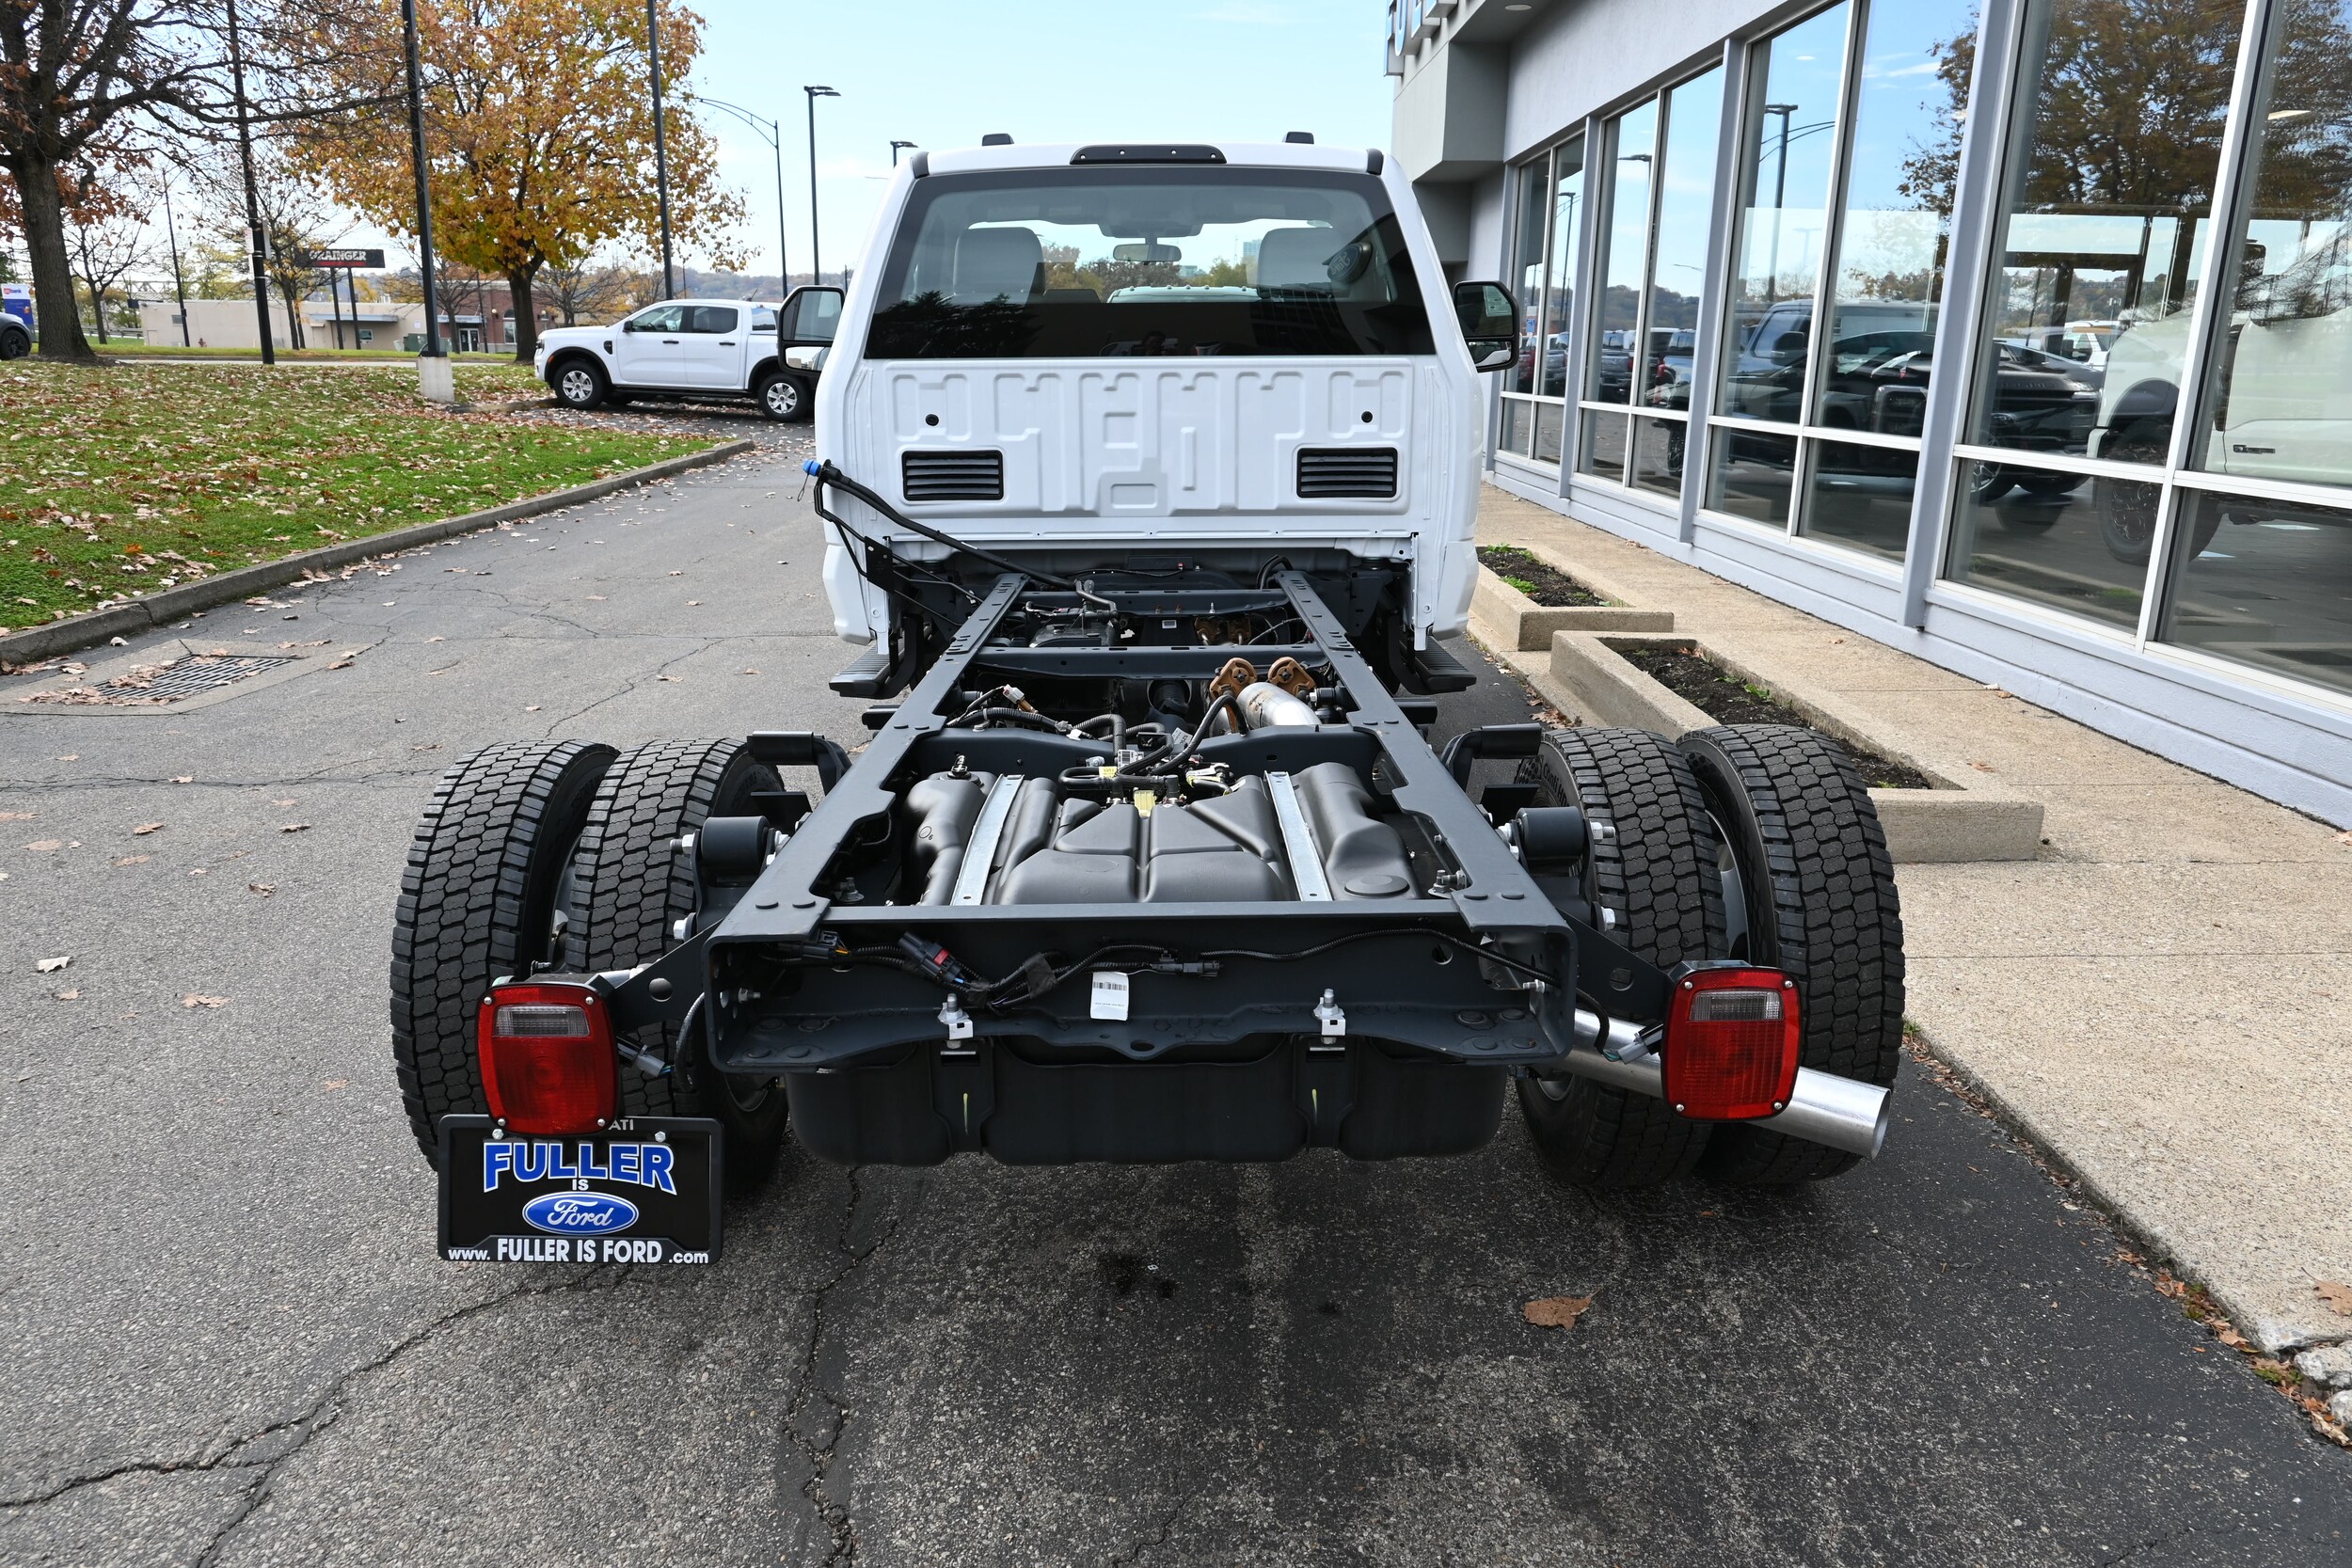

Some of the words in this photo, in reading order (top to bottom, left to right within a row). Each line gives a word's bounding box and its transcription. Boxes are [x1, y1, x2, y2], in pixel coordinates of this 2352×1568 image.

[483, 1142, 677, 1196] FULLER
[572, 1179, 589, 1191] IS
[546, 1198, 614, 1227] Ford
[448, 1248, 491, 1261] www.
[497, 1238, 569, 1262] FULLER
[577, 1239, 596, 1262] IS
[603, 1240, 662, 1263] FORD
[668, 1250, 708, 1264] .com
